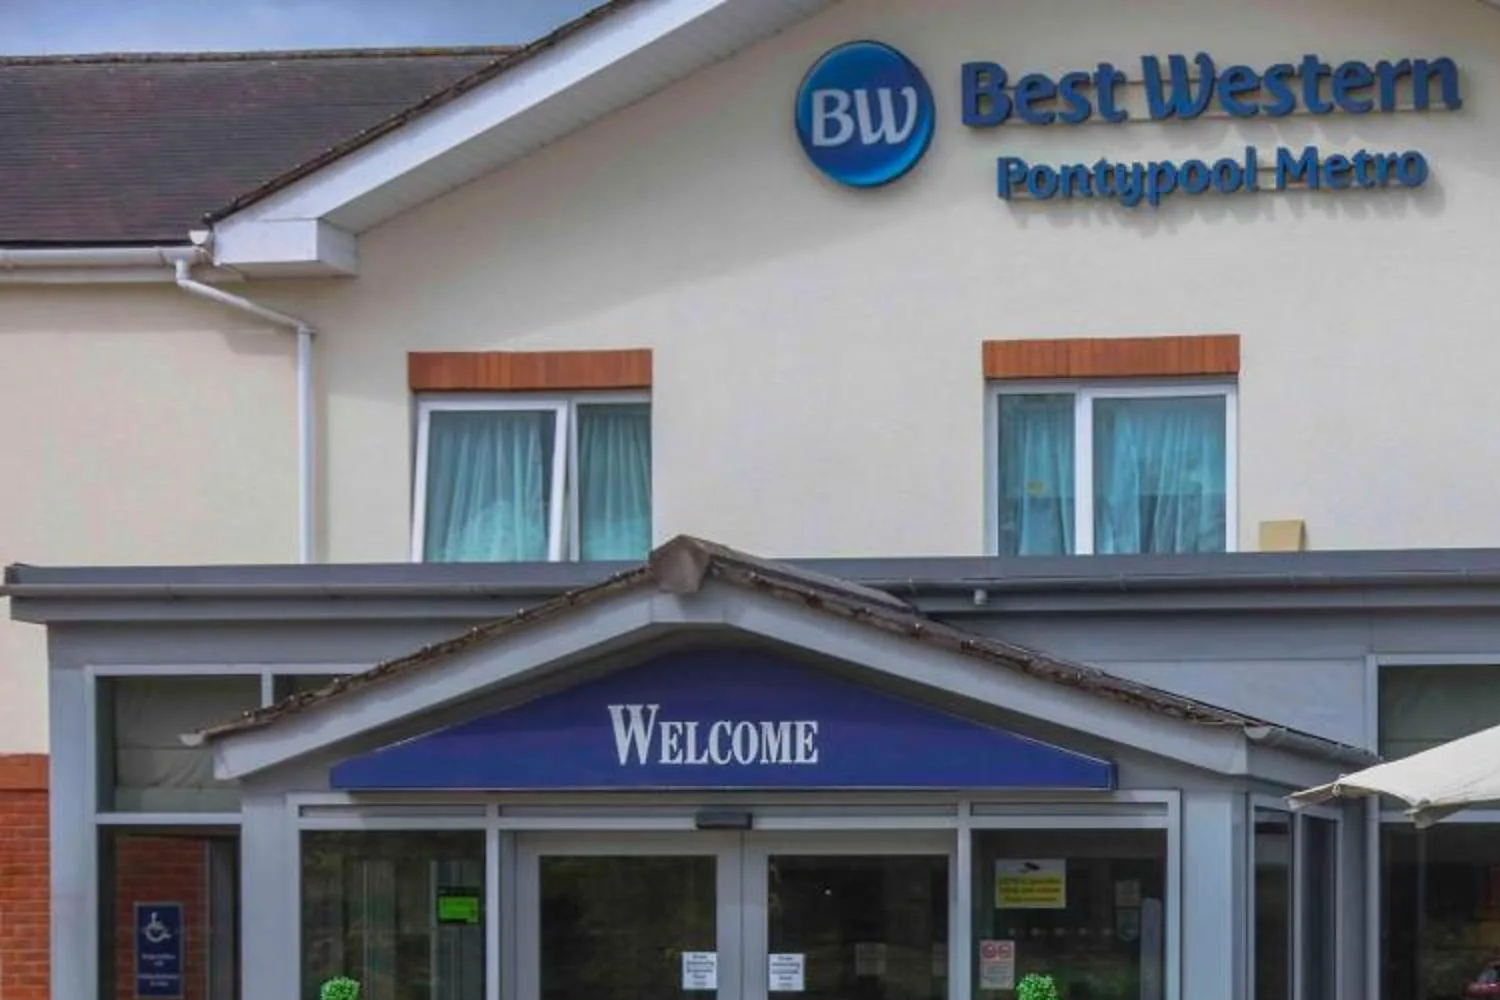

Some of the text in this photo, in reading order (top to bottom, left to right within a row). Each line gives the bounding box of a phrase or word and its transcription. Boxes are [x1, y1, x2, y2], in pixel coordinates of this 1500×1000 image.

[811, 87, 918, 148] BW
[960, 52, 1463, 128] Best Western
[997, 146, 1429, 207] Pontypool Metro
[607, 703, 819, 766] WELCOME
